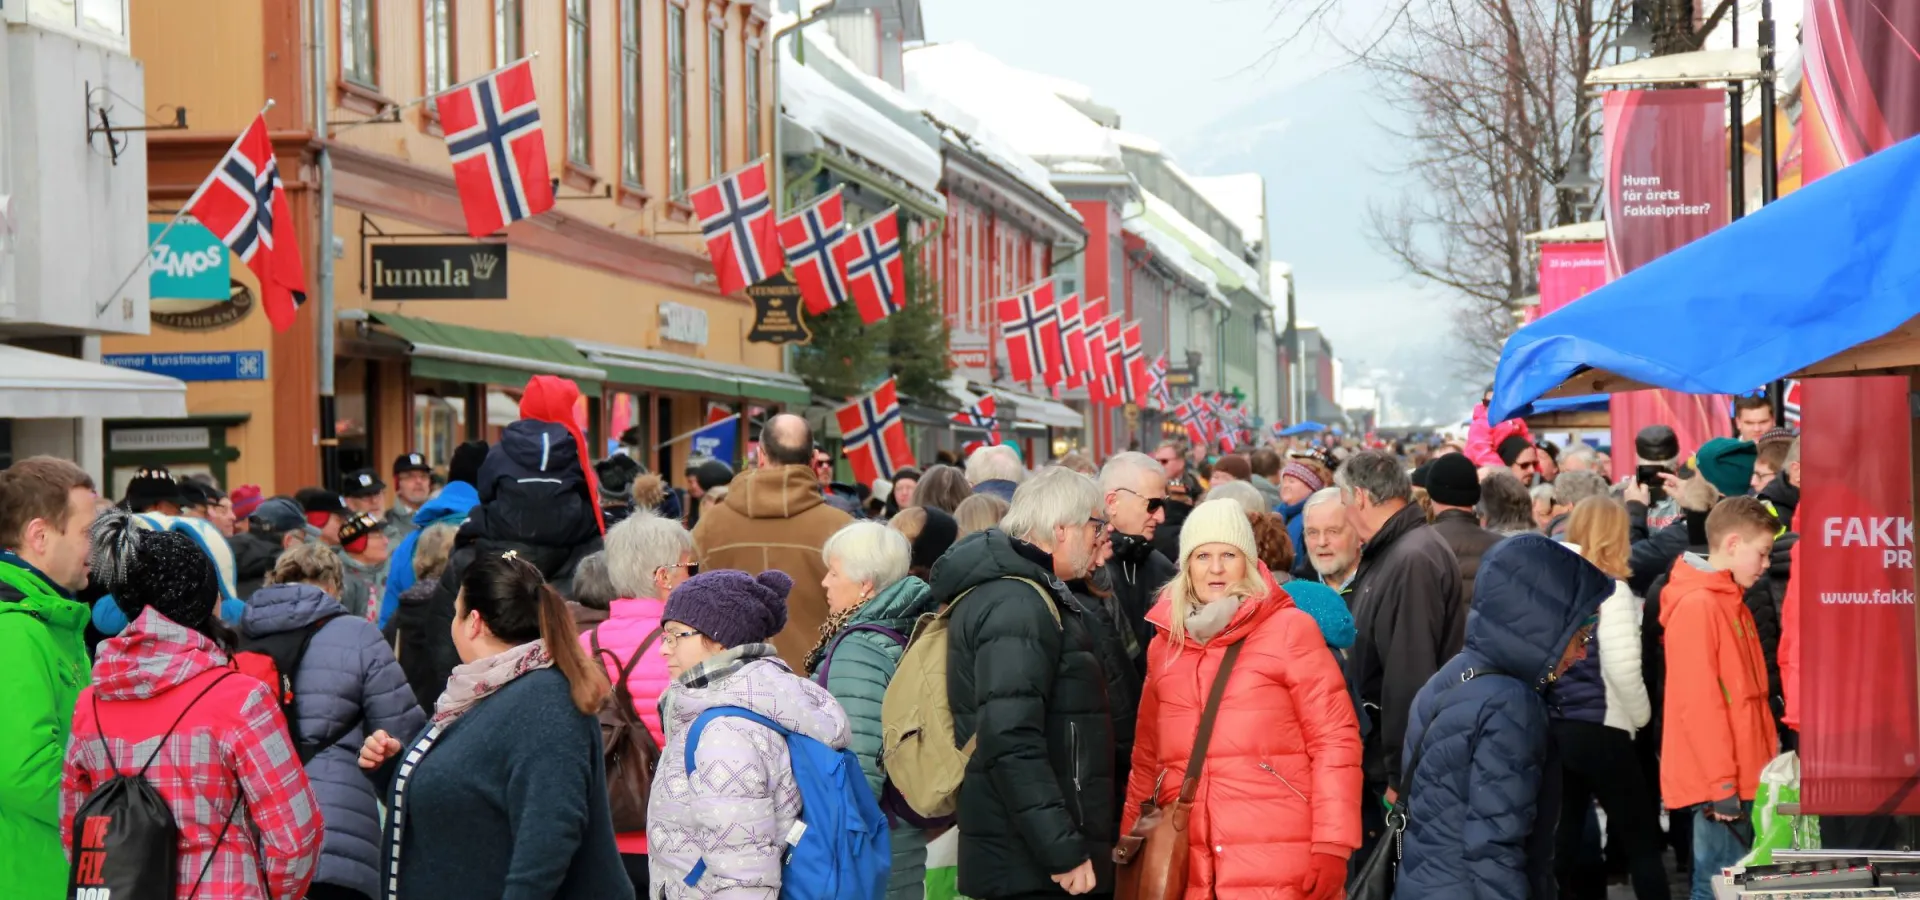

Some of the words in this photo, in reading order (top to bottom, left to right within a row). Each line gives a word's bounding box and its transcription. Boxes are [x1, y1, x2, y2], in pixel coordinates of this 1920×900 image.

[1622, 174, 1660, 187] Hvem
[1622, 189, 1642, 201] får
[1645, 188, 1680, 201] årets
[1623, 203, 1711, 218] Fakkelpriser?
[374, 258, 471, 287] lunula
[101, 355, 146, 367] hammer
[151, 354, 232, 367] kunstmuseum
[1823, 516, 1914, 547] FAKK
[1883, 549, 1914, 569] PR
[1820, 588, 1916, 605] www.fakk
[81, 815, 113, 849] WE
